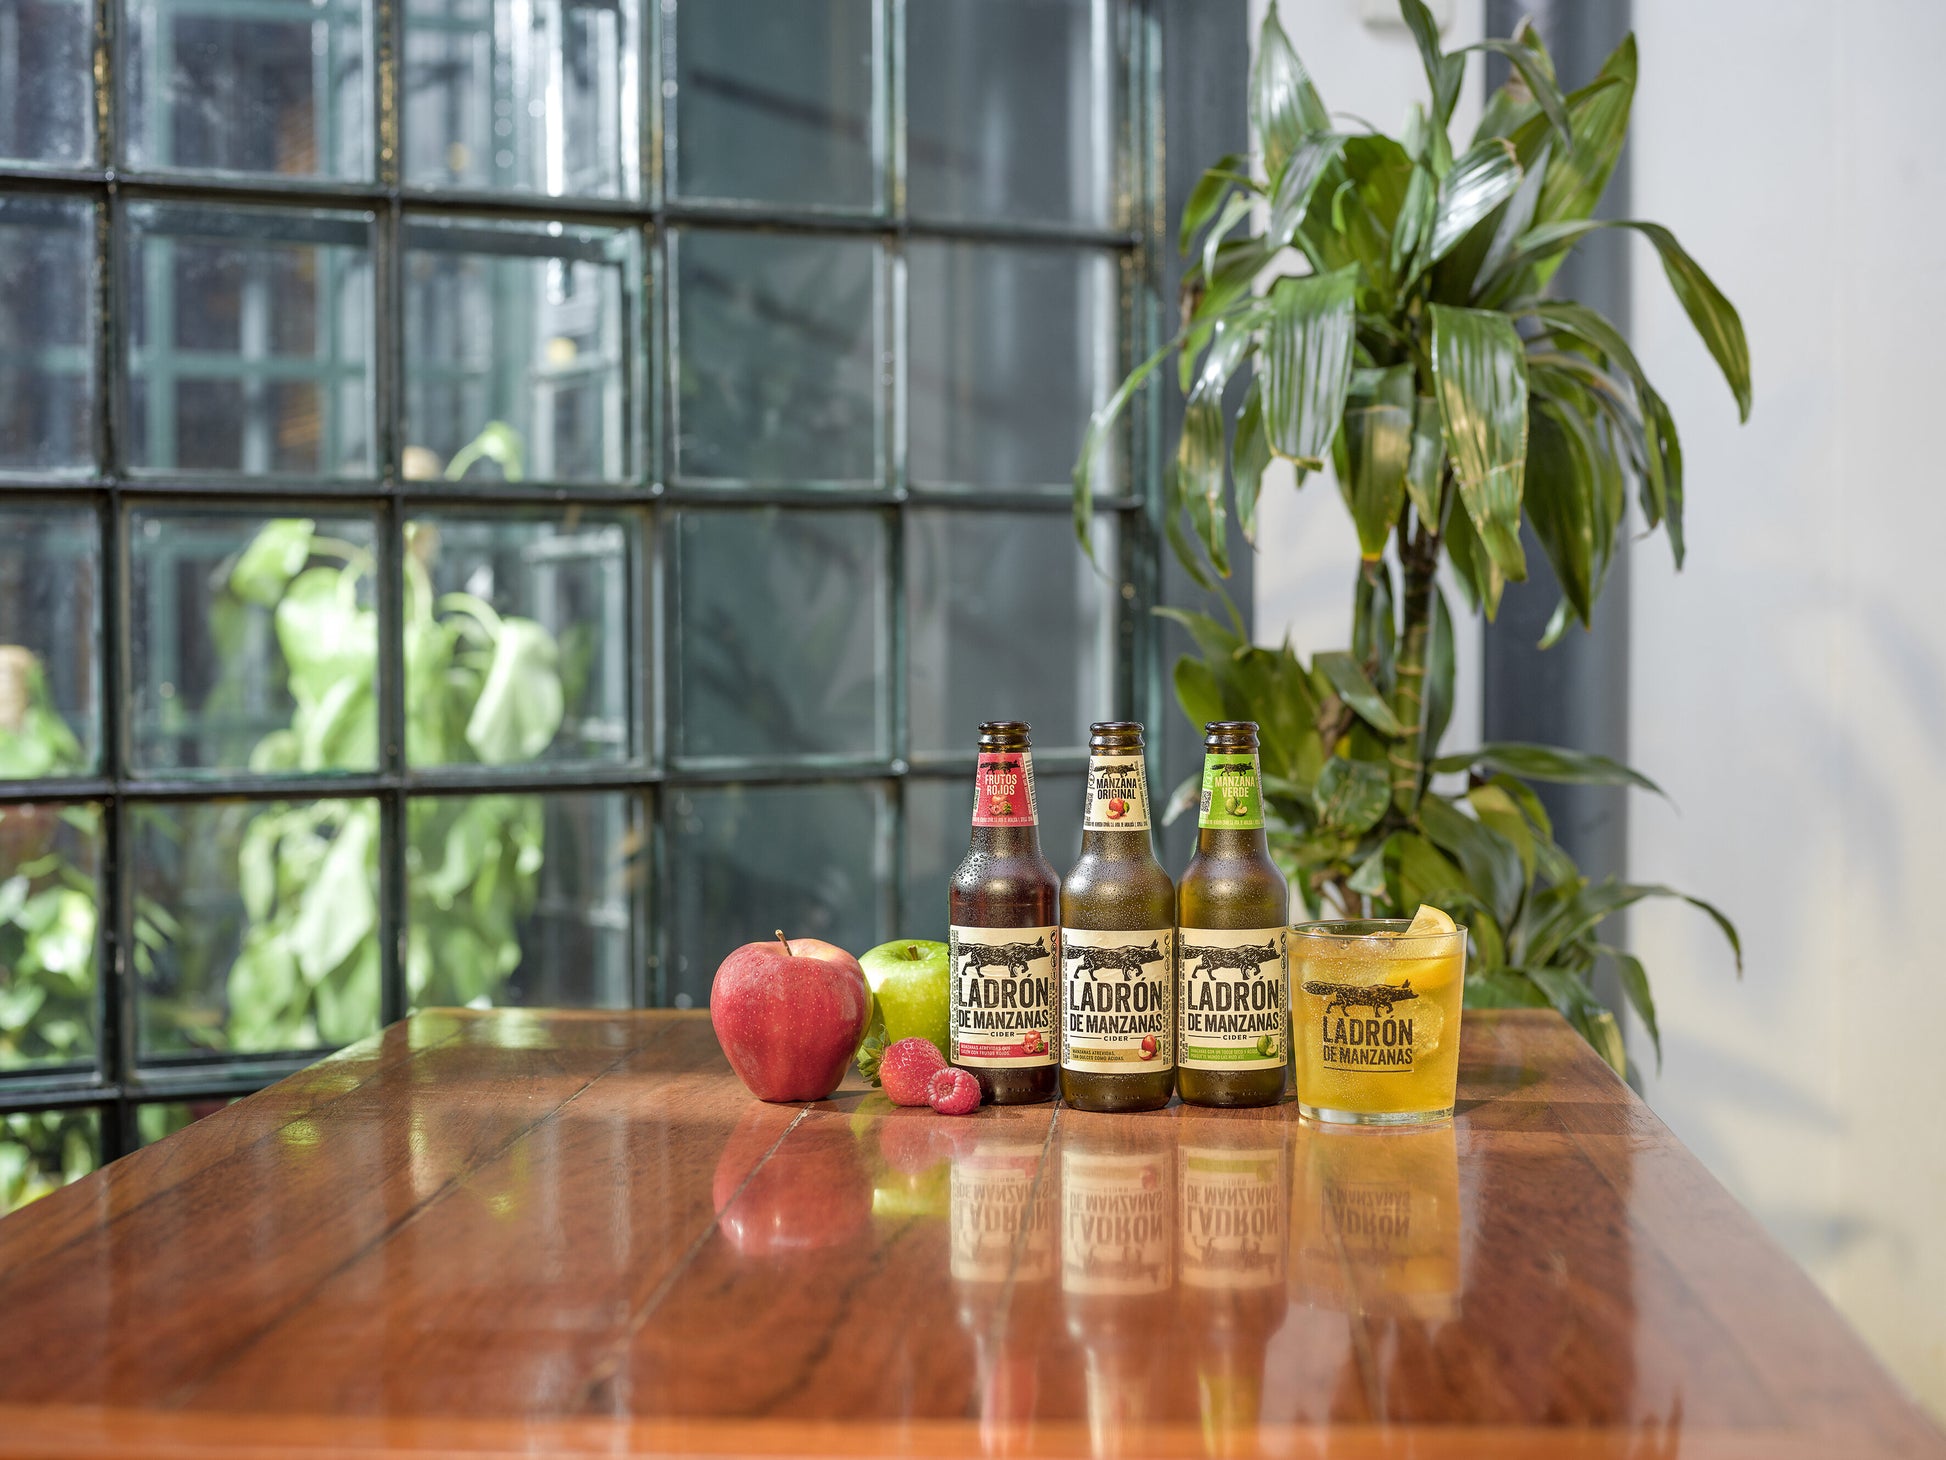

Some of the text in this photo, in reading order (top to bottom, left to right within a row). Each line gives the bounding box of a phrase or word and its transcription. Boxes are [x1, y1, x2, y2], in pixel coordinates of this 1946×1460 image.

[985, 774, 1017, 785] FRUTOS
[1096, 778, 1137, 789] MANZANA
[1214, 776, 1255, 787] MANZANA
[986, 785, 1015, 796] ROJOS
[1097, 789, 1136, 800] ORIGINAL
[1222, 787, 1249, 798] VERDE
[958, 974, 1049, 1009] LADRÓN
[1070, 977, 1162, 1012] LADRÓN
[1187, 976, 1279, 1012] LADRÓN
[959, 1009, 1049, 1029] DE MANZANAS
[1070, 1013, 1162, 1033] DE MANZANAS
[1188, 1012, 1279, 1032] DE MANZANAS
[1323, 1015, 1413, 1047] LADRÓN
[1323, 1045, 1413, 1066] DE MANZANAS
